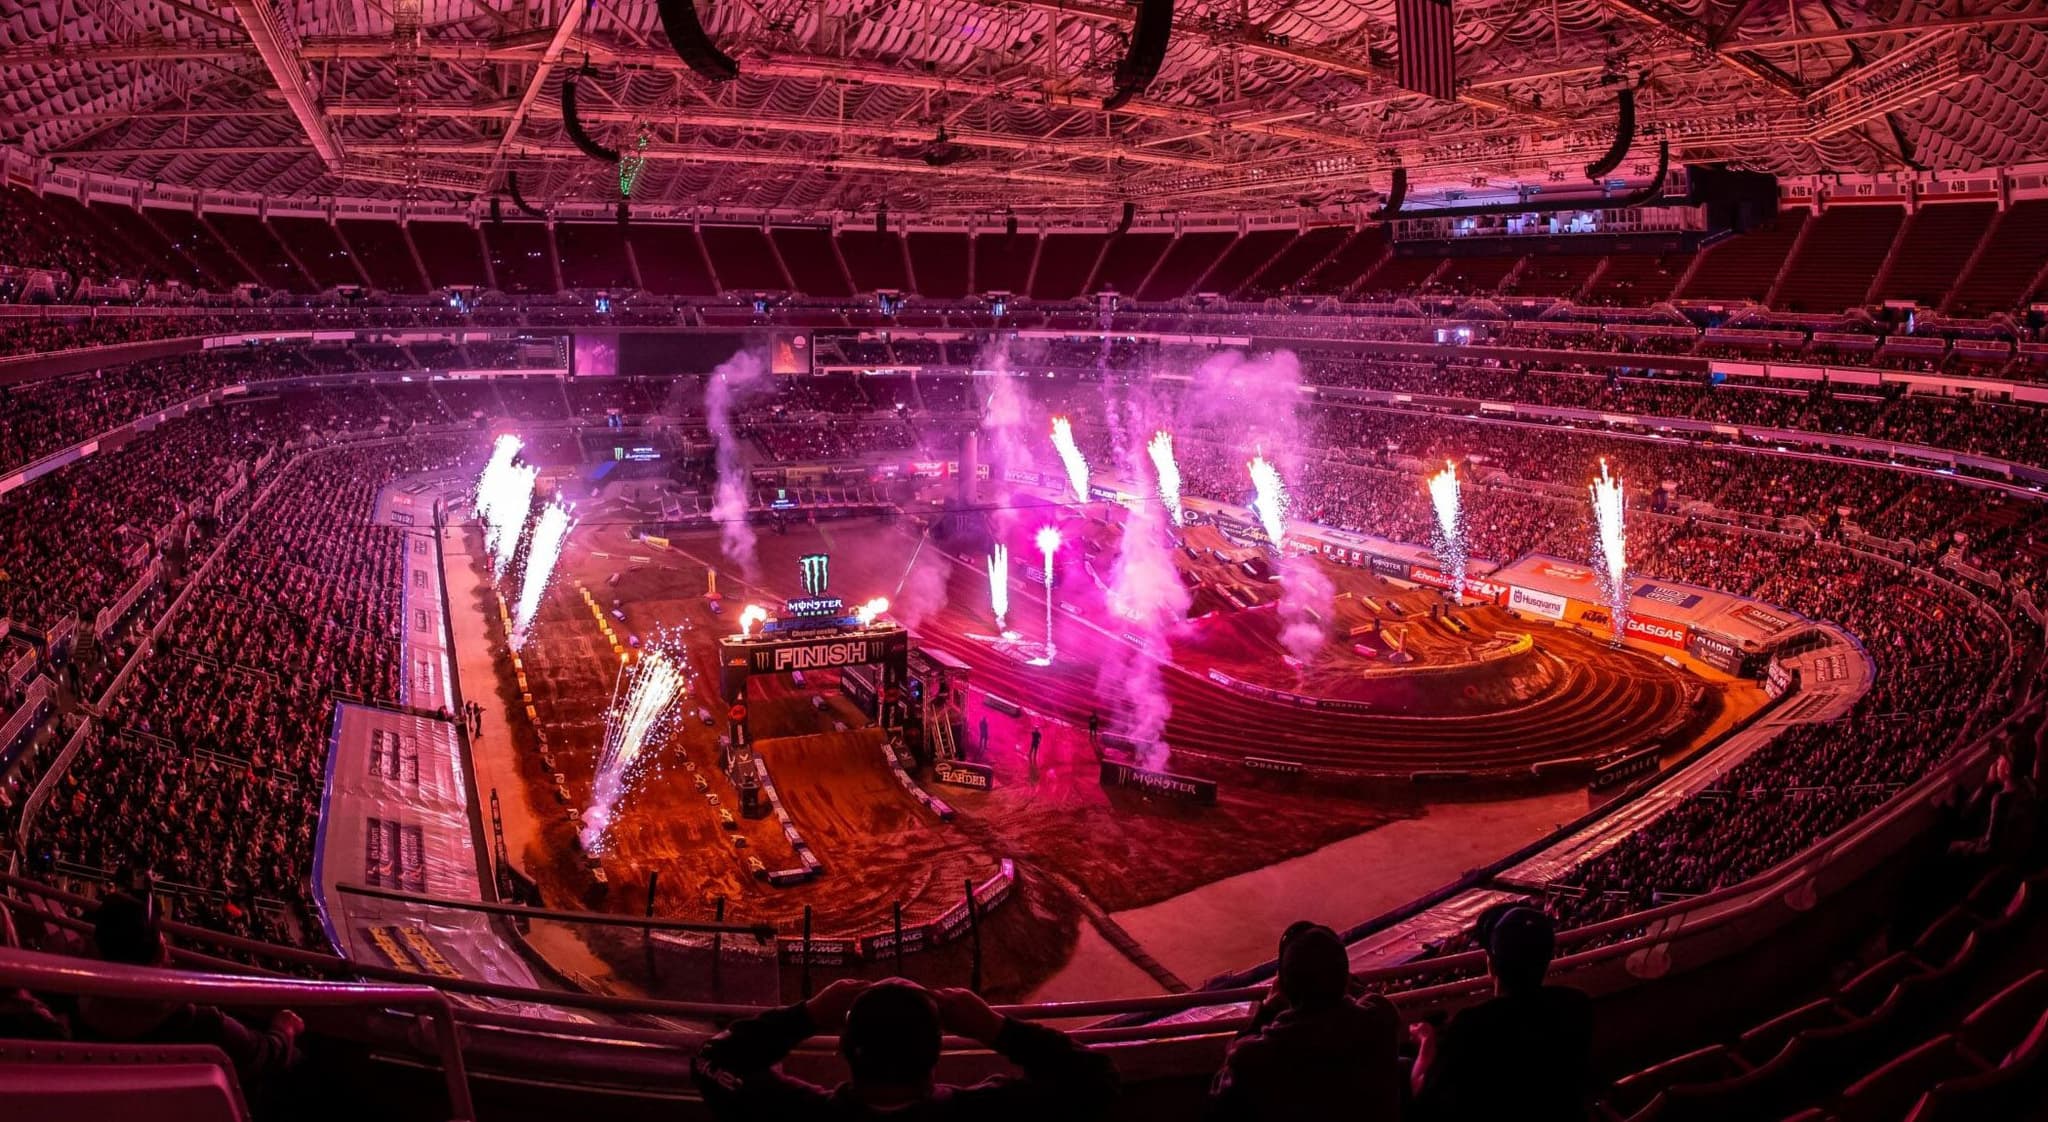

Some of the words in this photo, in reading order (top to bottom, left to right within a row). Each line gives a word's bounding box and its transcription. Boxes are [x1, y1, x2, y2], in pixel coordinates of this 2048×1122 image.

[1857, 184, 1873, 195] 417
[788, 599, 844, 612] MONSTER
[1521, 593, 1561, 612] Husqvarna
[1581, 609, 1609, 625] KTM
[1627, 619, 1683, 641] GASGAS
[775, 641, 867, 670] FINISH
[1133, 772, 1196, 795] MONSTER
